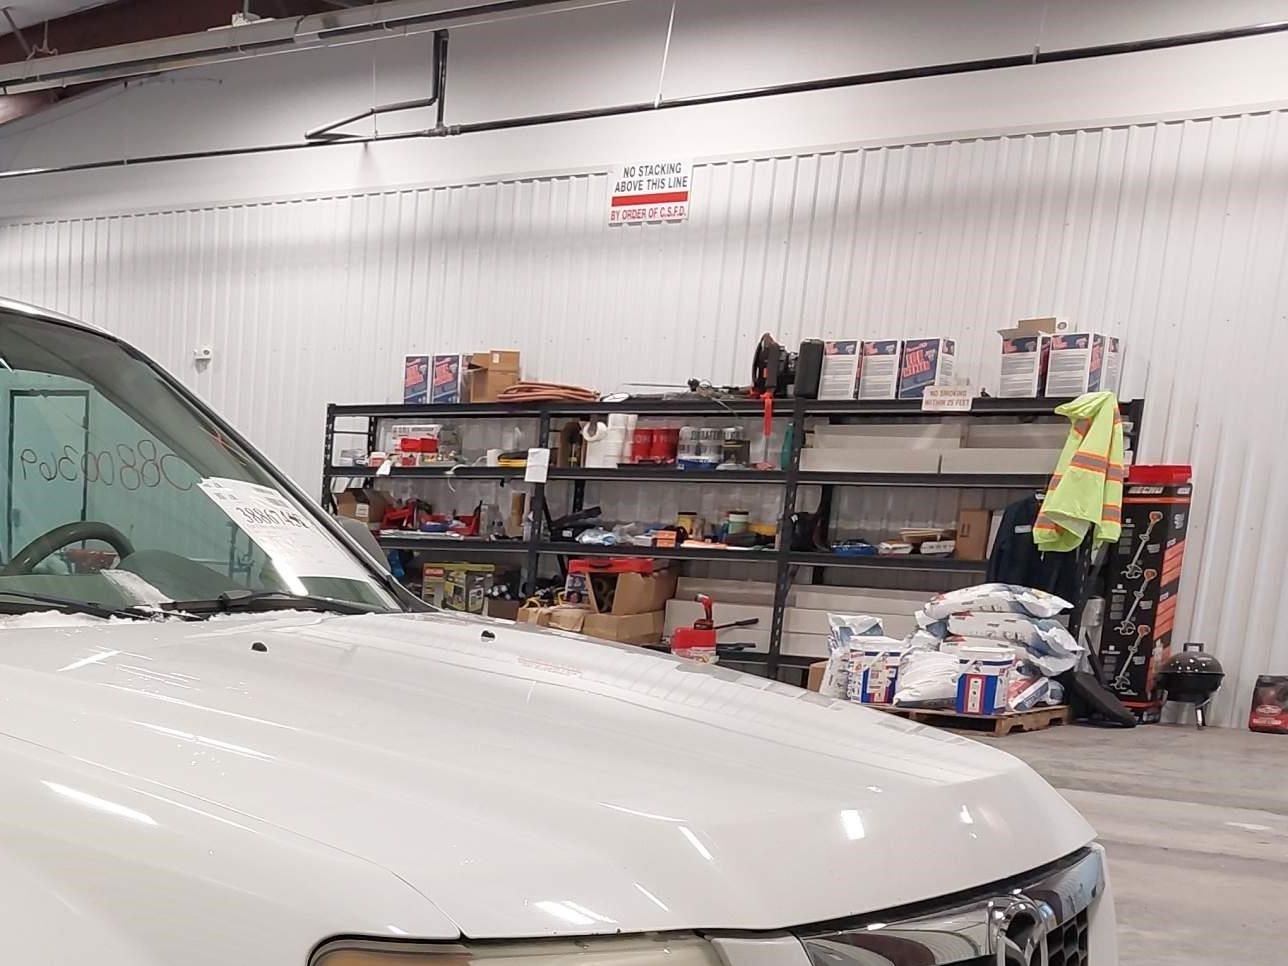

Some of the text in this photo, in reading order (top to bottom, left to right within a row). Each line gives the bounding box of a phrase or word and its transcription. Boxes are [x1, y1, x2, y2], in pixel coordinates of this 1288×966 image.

[623, 162, 682, 178] NO STACKING
[614, 176, 689, 193] ABOVE THIS LINE
[610, 210, 621, 221] BY
[622, 208, 647, 220] ORDER
[648, 207, 659, 218] OF
